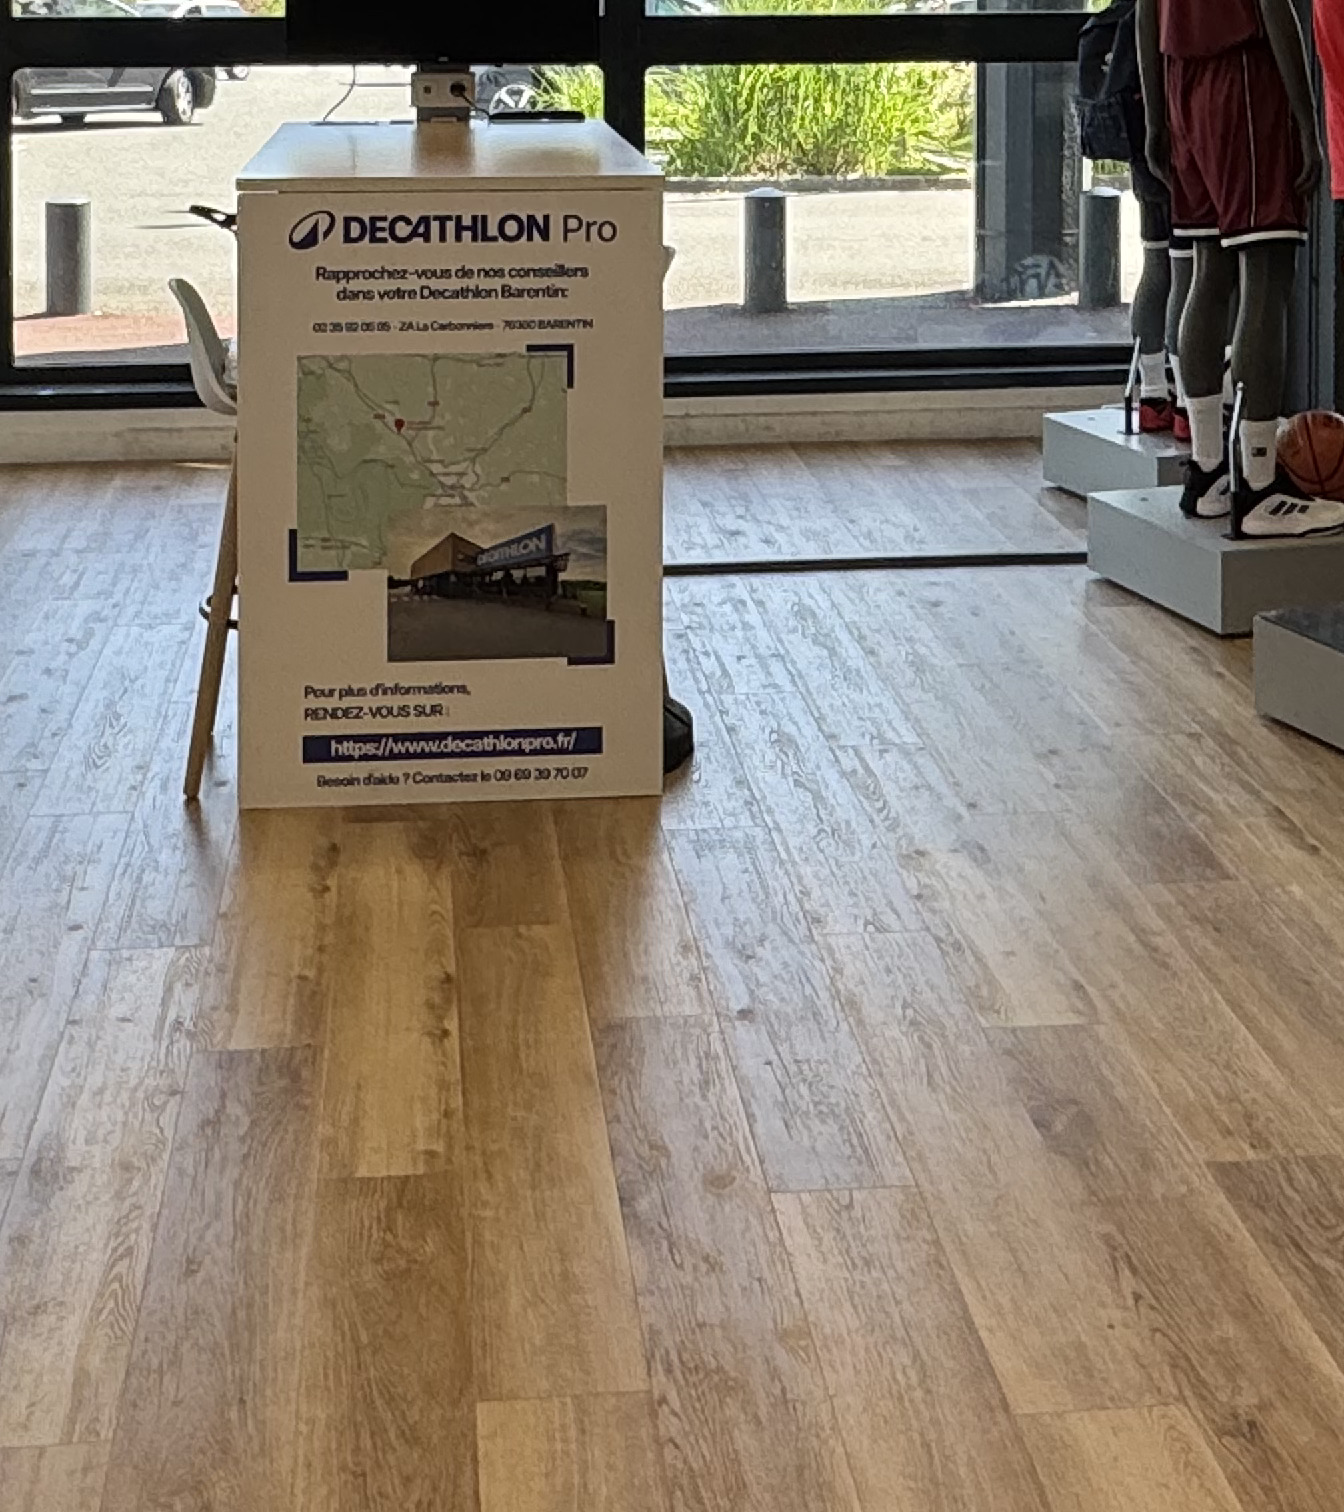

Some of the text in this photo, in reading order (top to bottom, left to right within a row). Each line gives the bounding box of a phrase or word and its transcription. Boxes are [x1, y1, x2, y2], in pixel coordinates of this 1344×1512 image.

[342, 213, 618, 244] DECATHLON Pro
[315, 263, 590, 284] Rapprochez-vous de nos conseillers
[336, 287, 375, 301] dans
[377, 287, 418, 301] votre
[419, 284, 498, 300] Decathlon
[537, 318, 594, 330] BARENTIN
[304, 685, 336, 699] Pour
[338, 684, 367, 701] plus
[304, 704, 410, 721] RENDEZ-VOUS
[413, 703, 443, 717] SUR
[330, 730, 577, 759] https://www.decathlonpro.fr/
[317, 771, 361, 788] Besoin
[412, 770, 478, 785] Contactez
